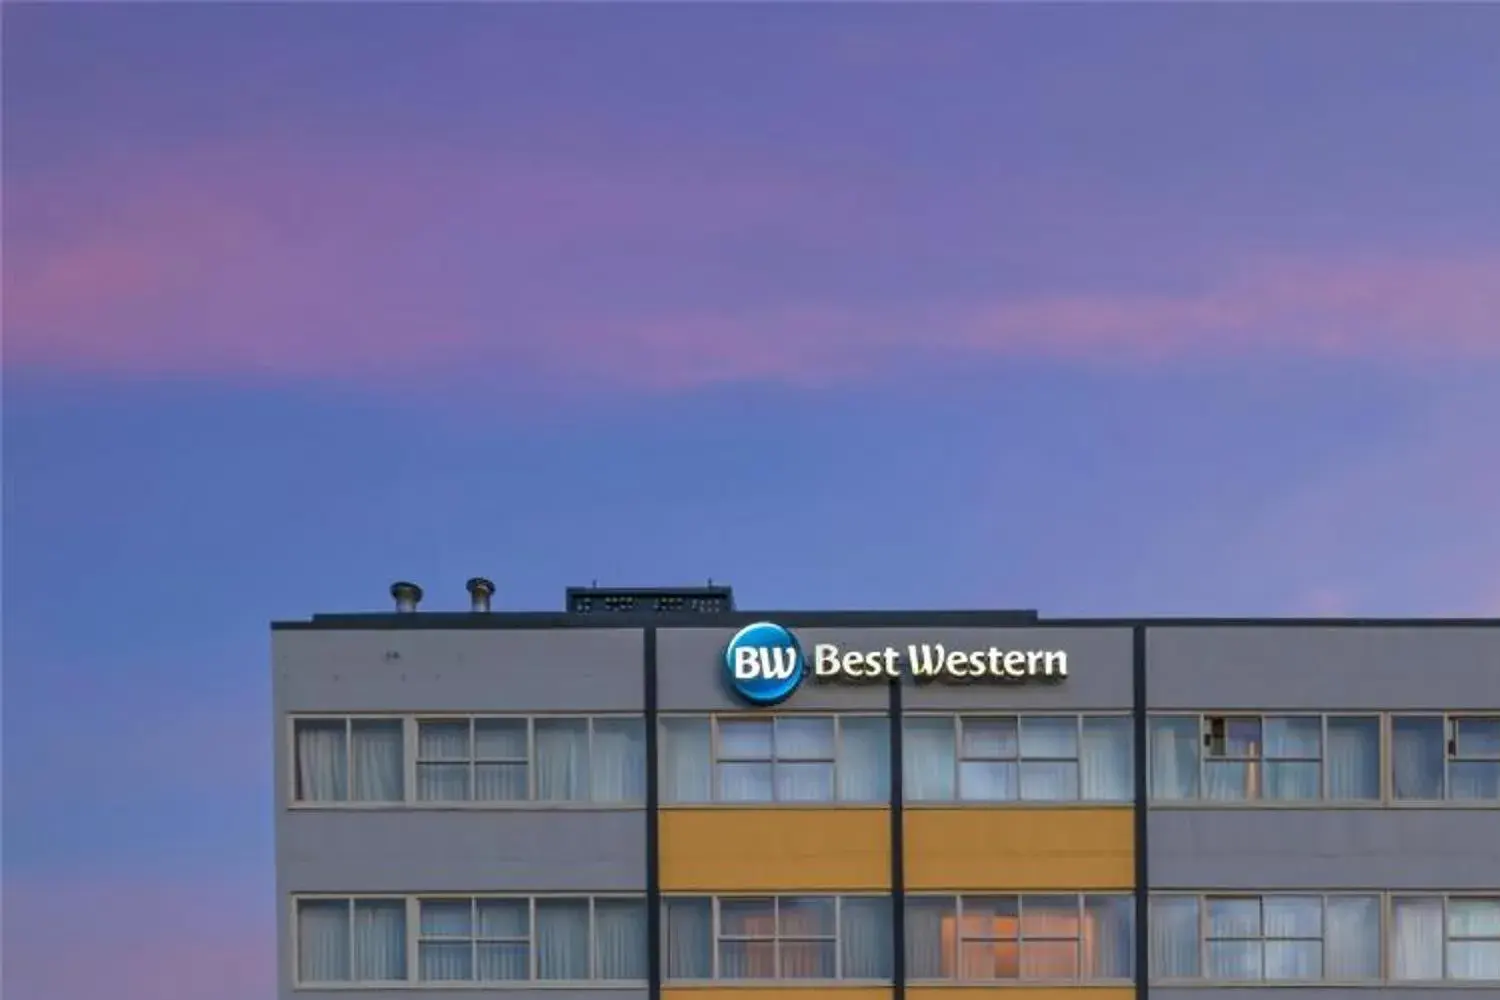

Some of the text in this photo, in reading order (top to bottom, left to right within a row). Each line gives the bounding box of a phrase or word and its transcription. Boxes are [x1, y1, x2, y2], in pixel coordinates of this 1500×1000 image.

[734, 645, 797, 679] BW
[814, 643, 1069, 677] Best Western
